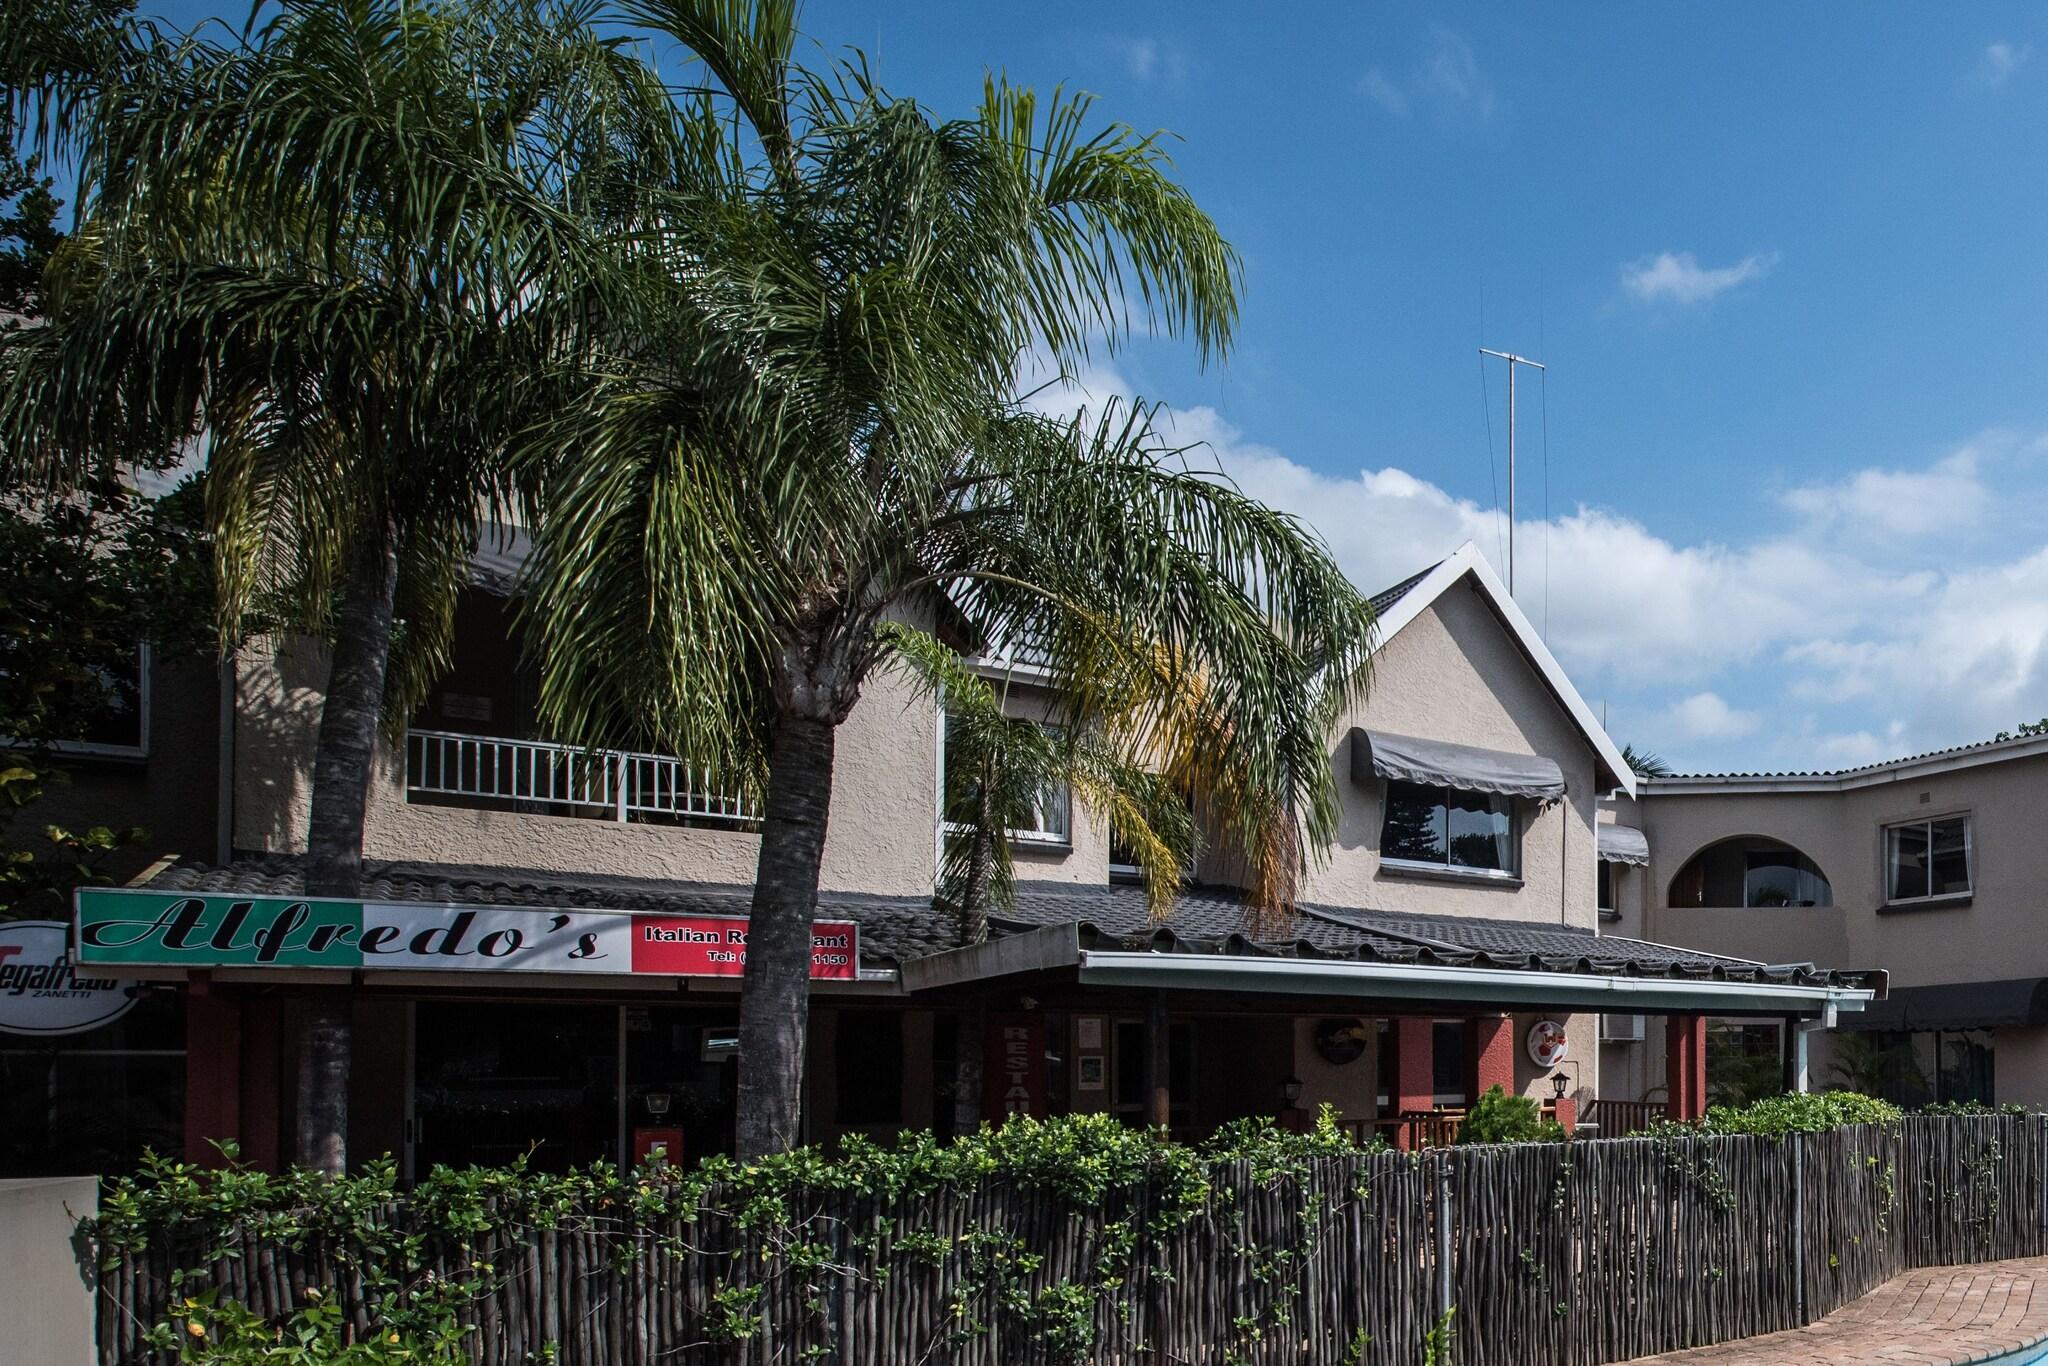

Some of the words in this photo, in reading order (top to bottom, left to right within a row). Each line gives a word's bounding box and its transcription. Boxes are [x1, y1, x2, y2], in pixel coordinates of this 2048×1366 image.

[82, 898, 608, 963] Alfredo's
[645, 926, 719, 943] Italian
[707, 951, 736, 963] Tel:
[32, 990, 91, 999] ZANETTI
[1003, 1026, 1031, 1114] RESTAU
